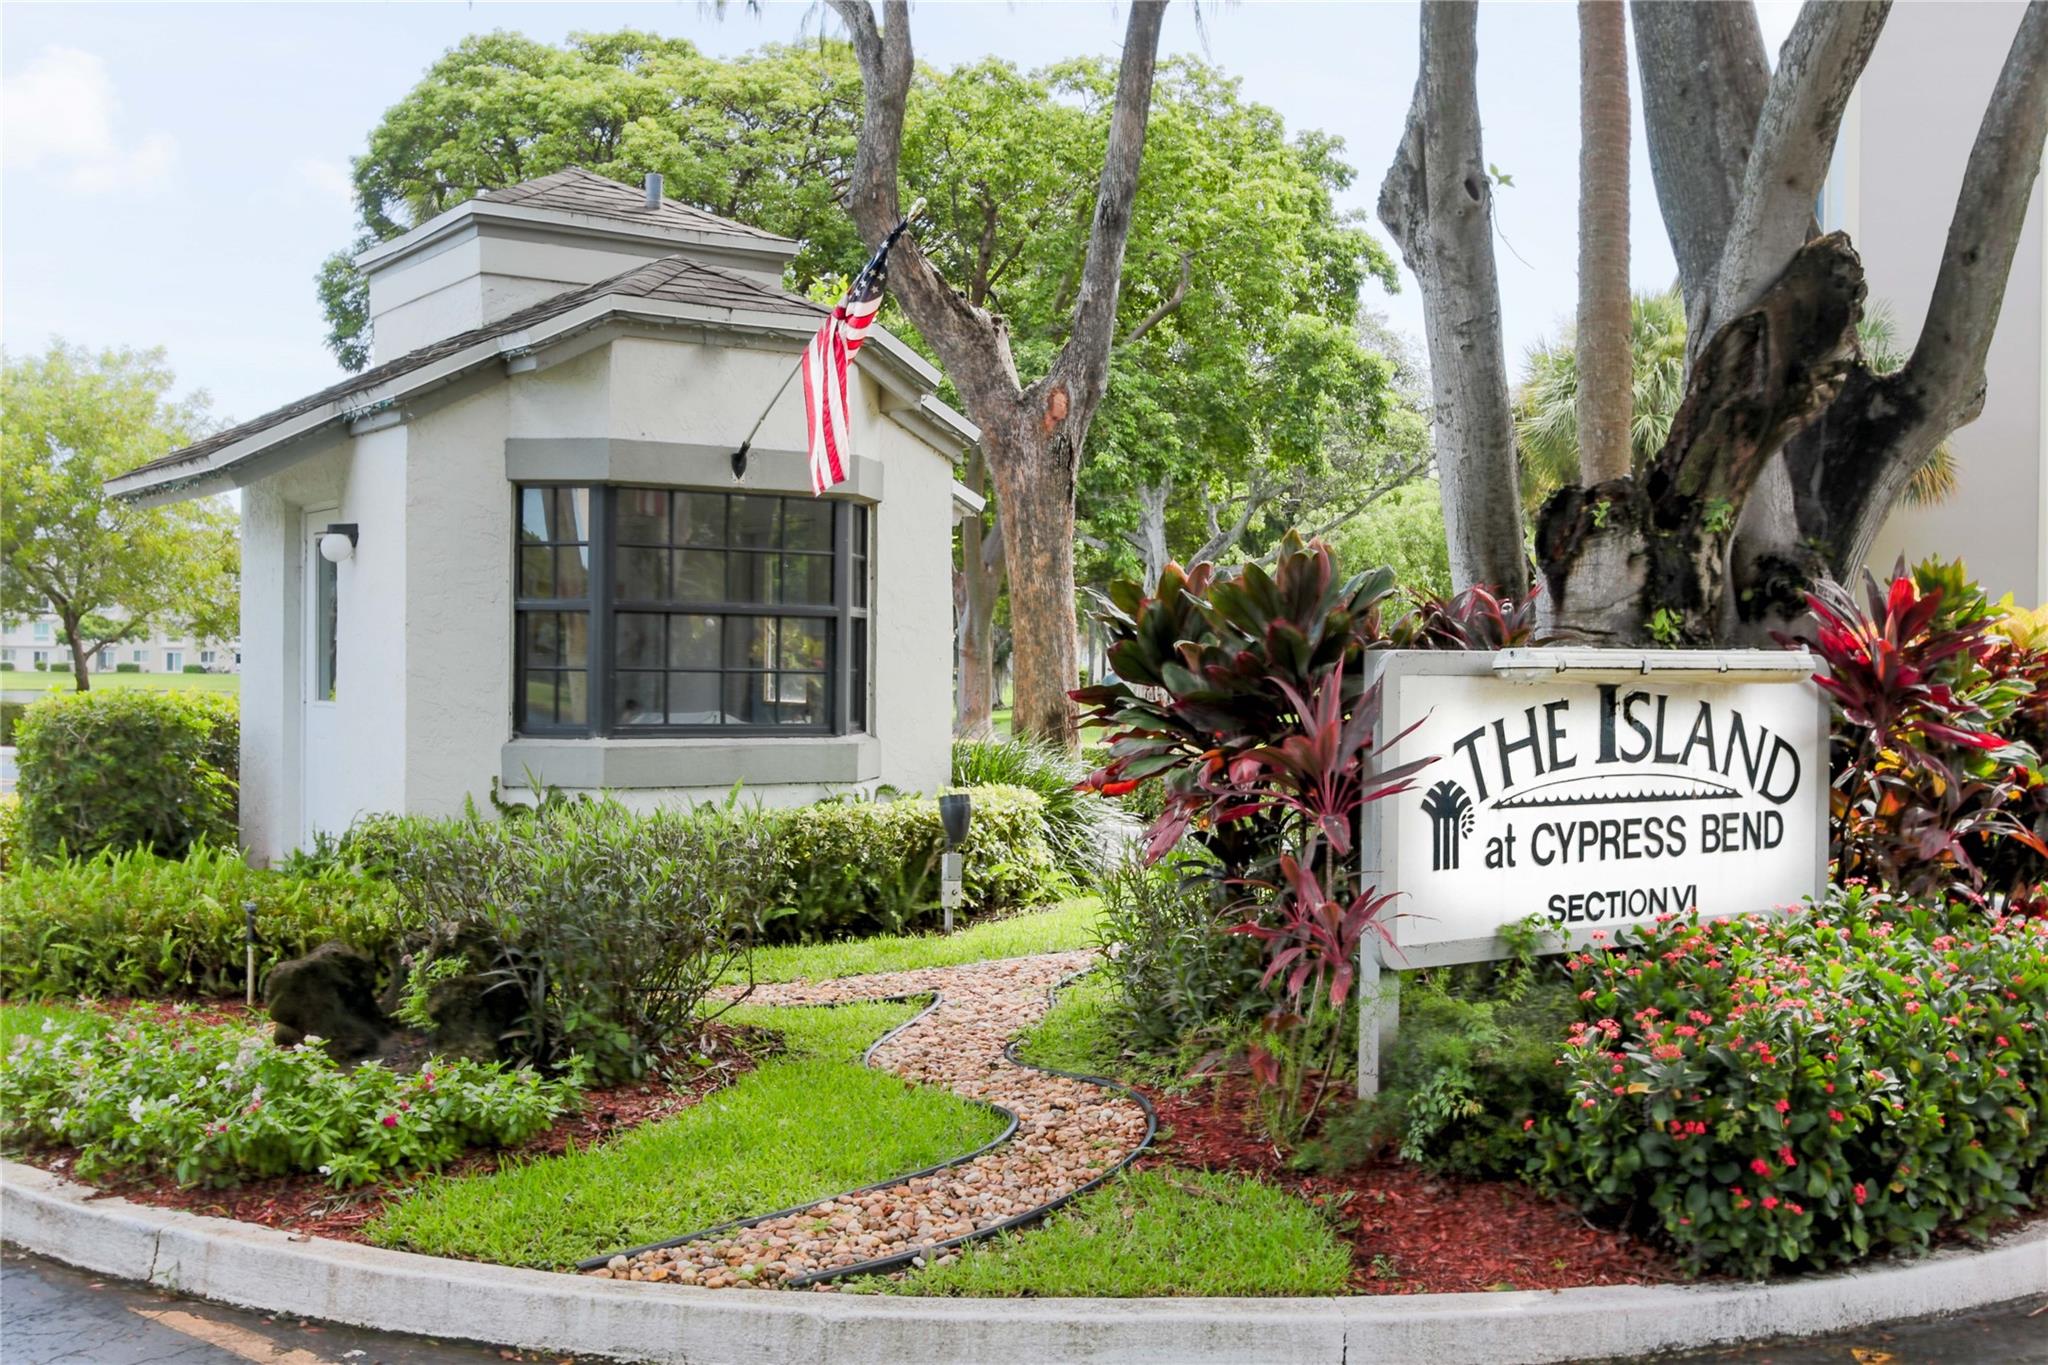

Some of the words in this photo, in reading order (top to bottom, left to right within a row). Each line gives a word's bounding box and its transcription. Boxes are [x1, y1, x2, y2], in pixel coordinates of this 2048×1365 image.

[1452, 698, 1578, 802] THE
[1595, 683, 1801, 805] ISLAND
[1485, 822, 1517, 869] at
[1530, 814, 1687, 867] CYPRESS
[1701, 809, 1784, 854] BEND
[1547, 888, 1668, 923] SECTION
